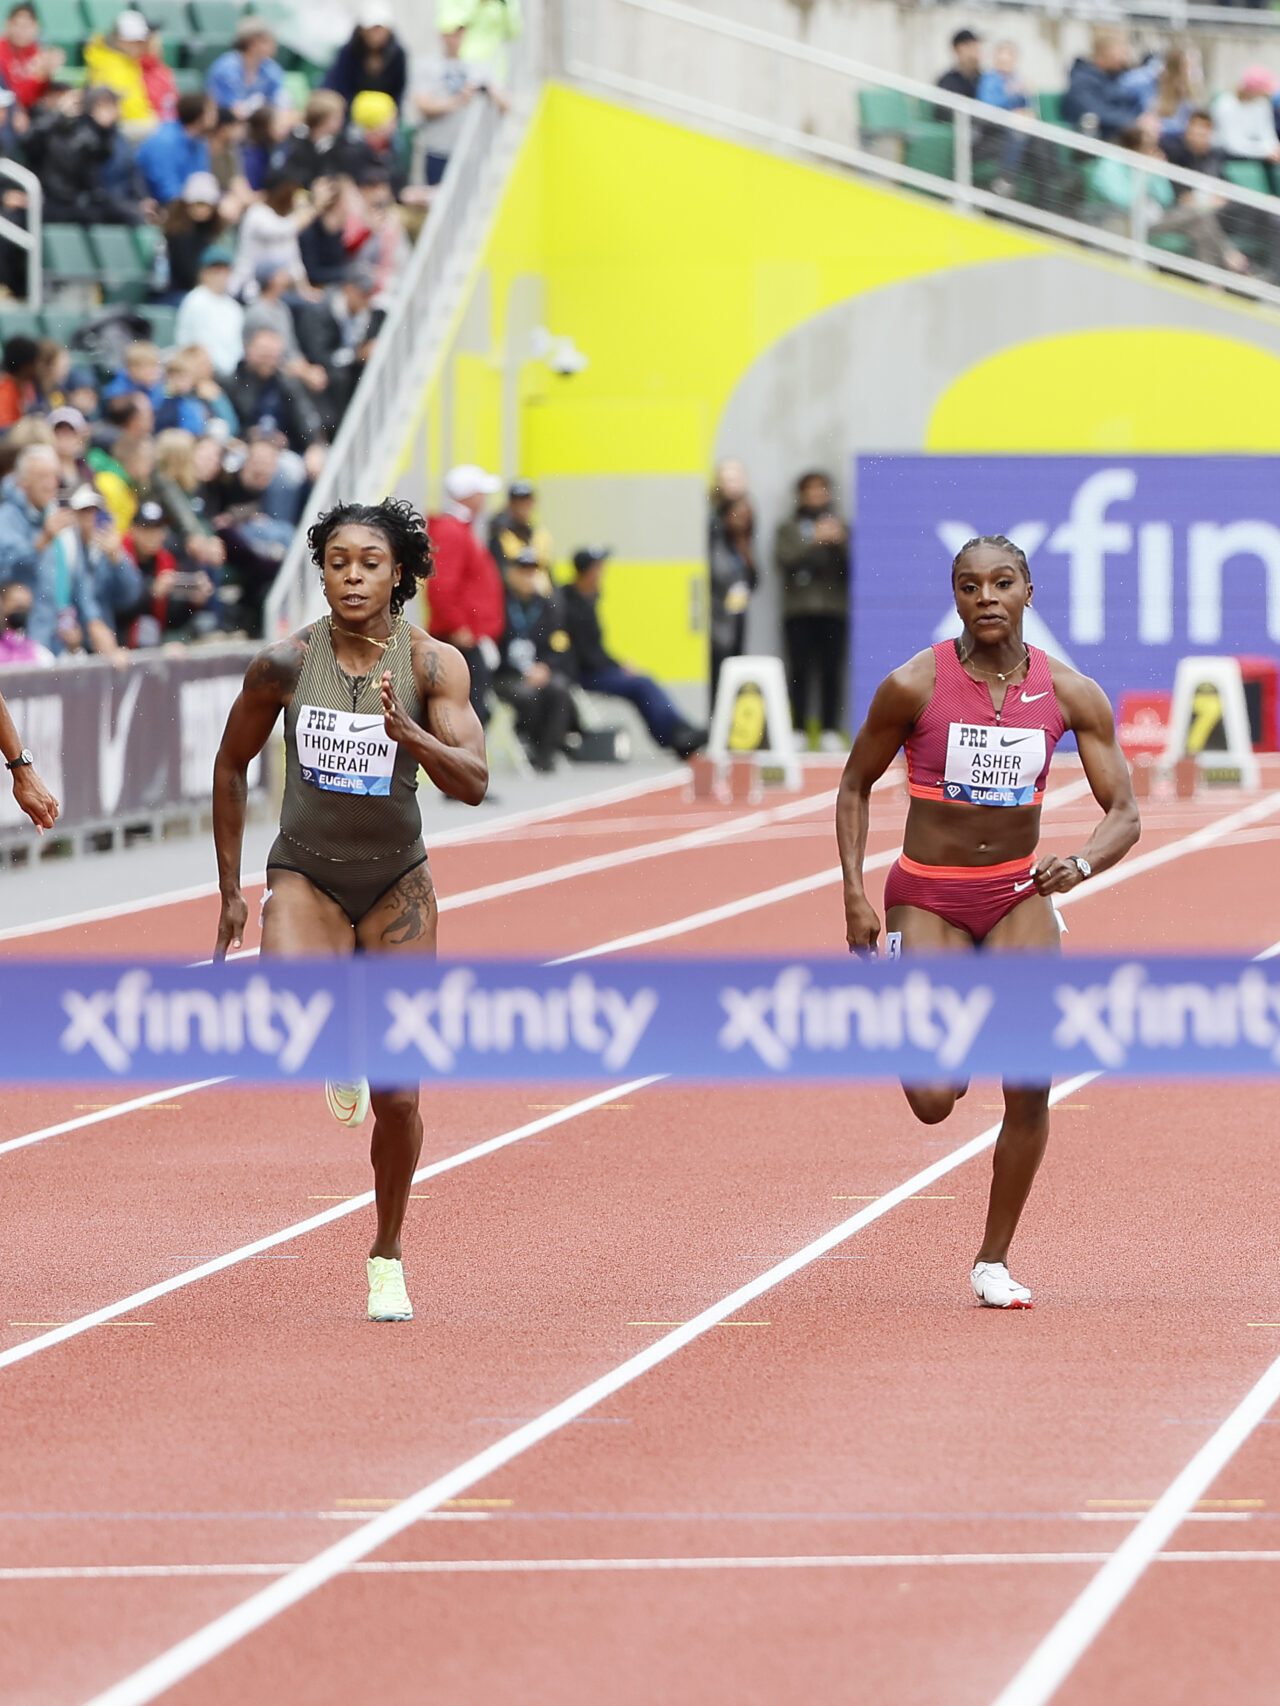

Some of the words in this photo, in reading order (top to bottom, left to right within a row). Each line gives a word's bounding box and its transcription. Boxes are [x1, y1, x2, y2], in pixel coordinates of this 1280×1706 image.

[306, 710, 338, 732] PRE
[303, 733, 389, 758] THOMPSON
[959, 727, 988, 748] PRE
[317, 752, 369, 773] HERAH
[971, 752, 1022, 770] ASHER
[318, 773, 364, 789] EUGENE
[971, 769, 1018, 786] SMITH
[970, 789, 1015, 801] EUGENE
[59, 968, 336, 1074] xfinity
[383, 967, 658, 1072] xfinity
[718, 963, 995, 1071] xfinity
